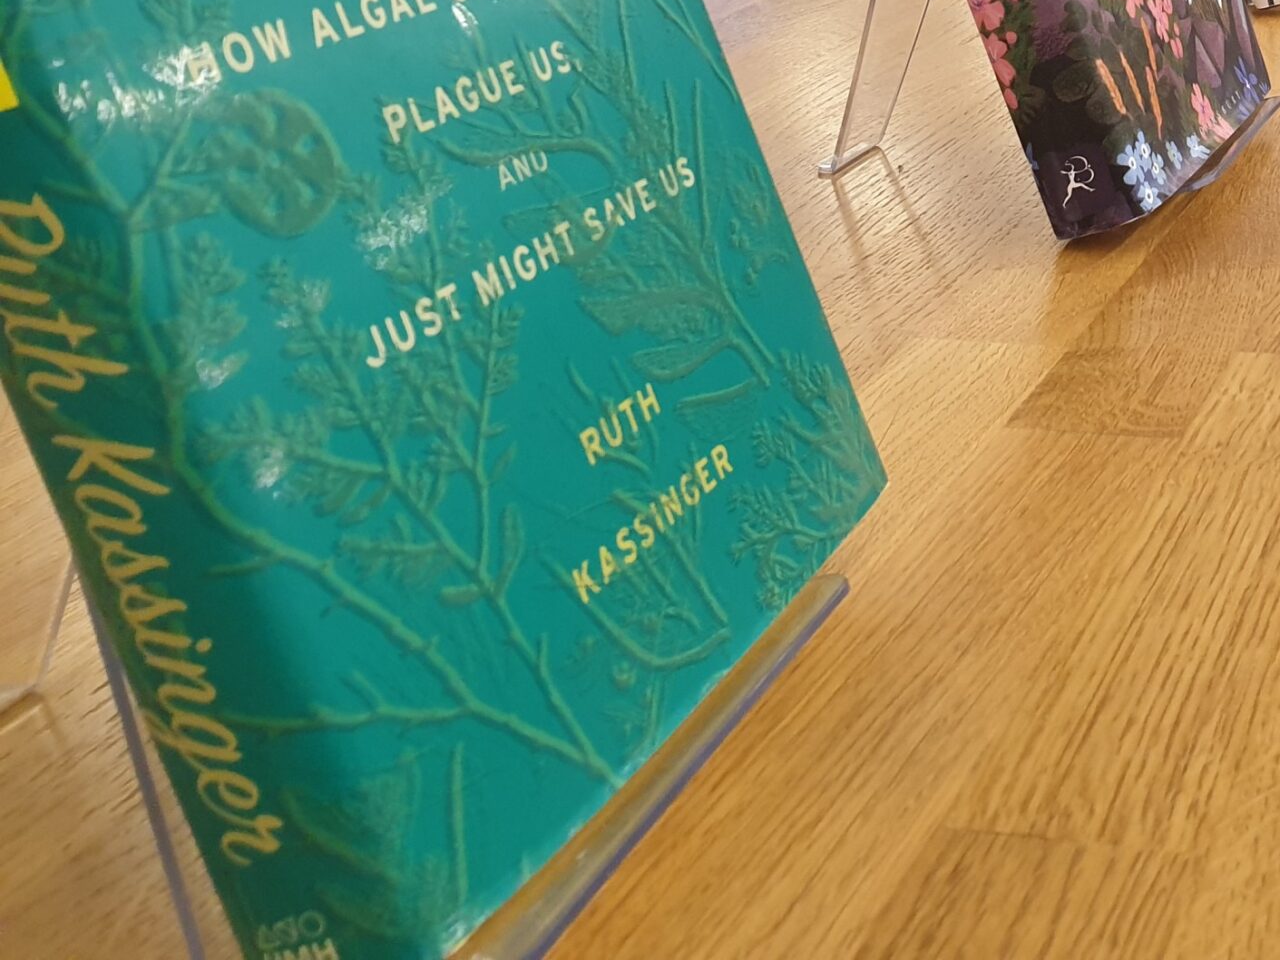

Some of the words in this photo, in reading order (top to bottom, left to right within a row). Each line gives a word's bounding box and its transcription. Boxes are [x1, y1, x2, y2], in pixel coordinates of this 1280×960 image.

[186, 18, 292, 83] HOW
[383, 58, 524, 144] PLAGUE
[498, 150, 549, 192] AND
[365, 284, 463, 368] JUST
[472, 222, 576, 306] MIGHT
[584, 176, 657, 242] SAVE
[660, 156, 697, 200] US
[578, 383, 662, 467] RUTH
[571, 443, 736, 605] KASSINGER
[51, 433, 283, 868] Kassinger
